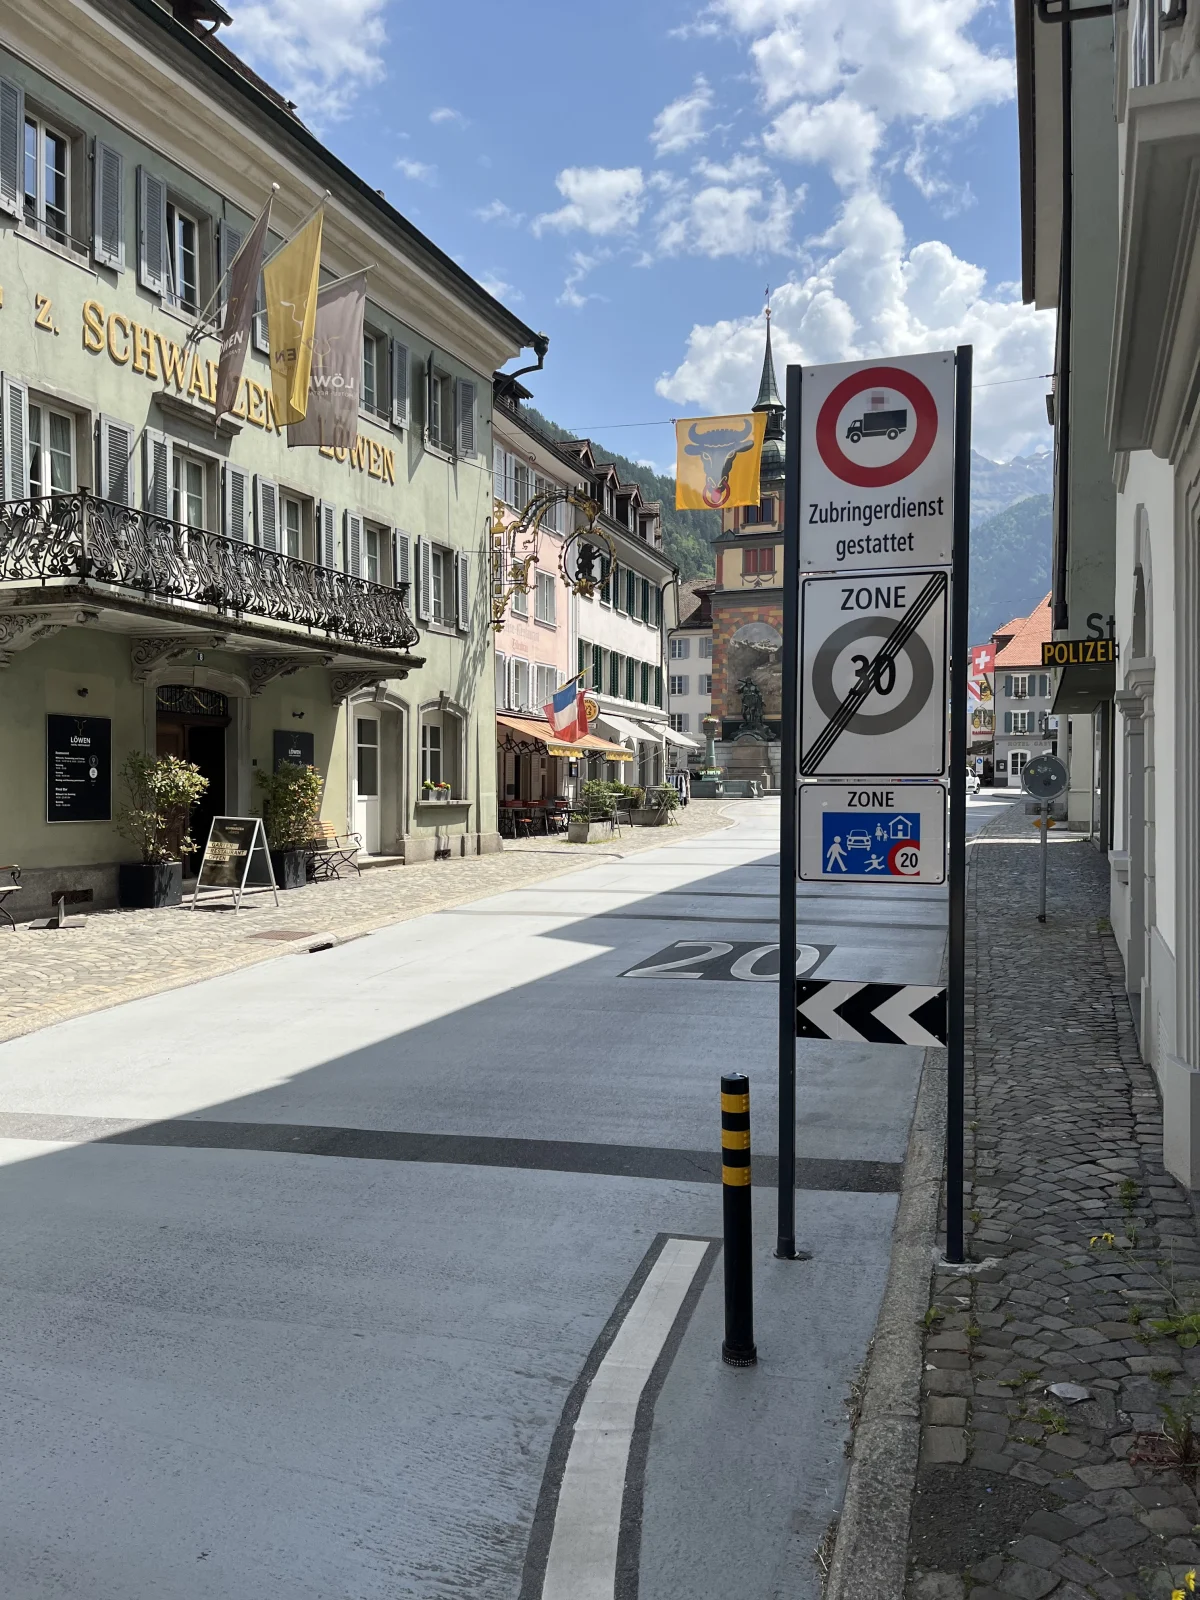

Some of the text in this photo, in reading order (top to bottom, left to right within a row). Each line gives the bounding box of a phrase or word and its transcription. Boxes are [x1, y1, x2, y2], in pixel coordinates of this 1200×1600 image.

[809, 497, 944, 526] Zubringerdienst
[836, 532, 914, 561] gestattet
[841, 586, 906, 611] ZONE
[1044, 640, 1113, 664] POLIZEI
[849, 654, 896, 696] 30
[847, 791, 895, 808] ZONE
[900, 852, 919, 869] 20
[623, 941, 820, 981] 20
